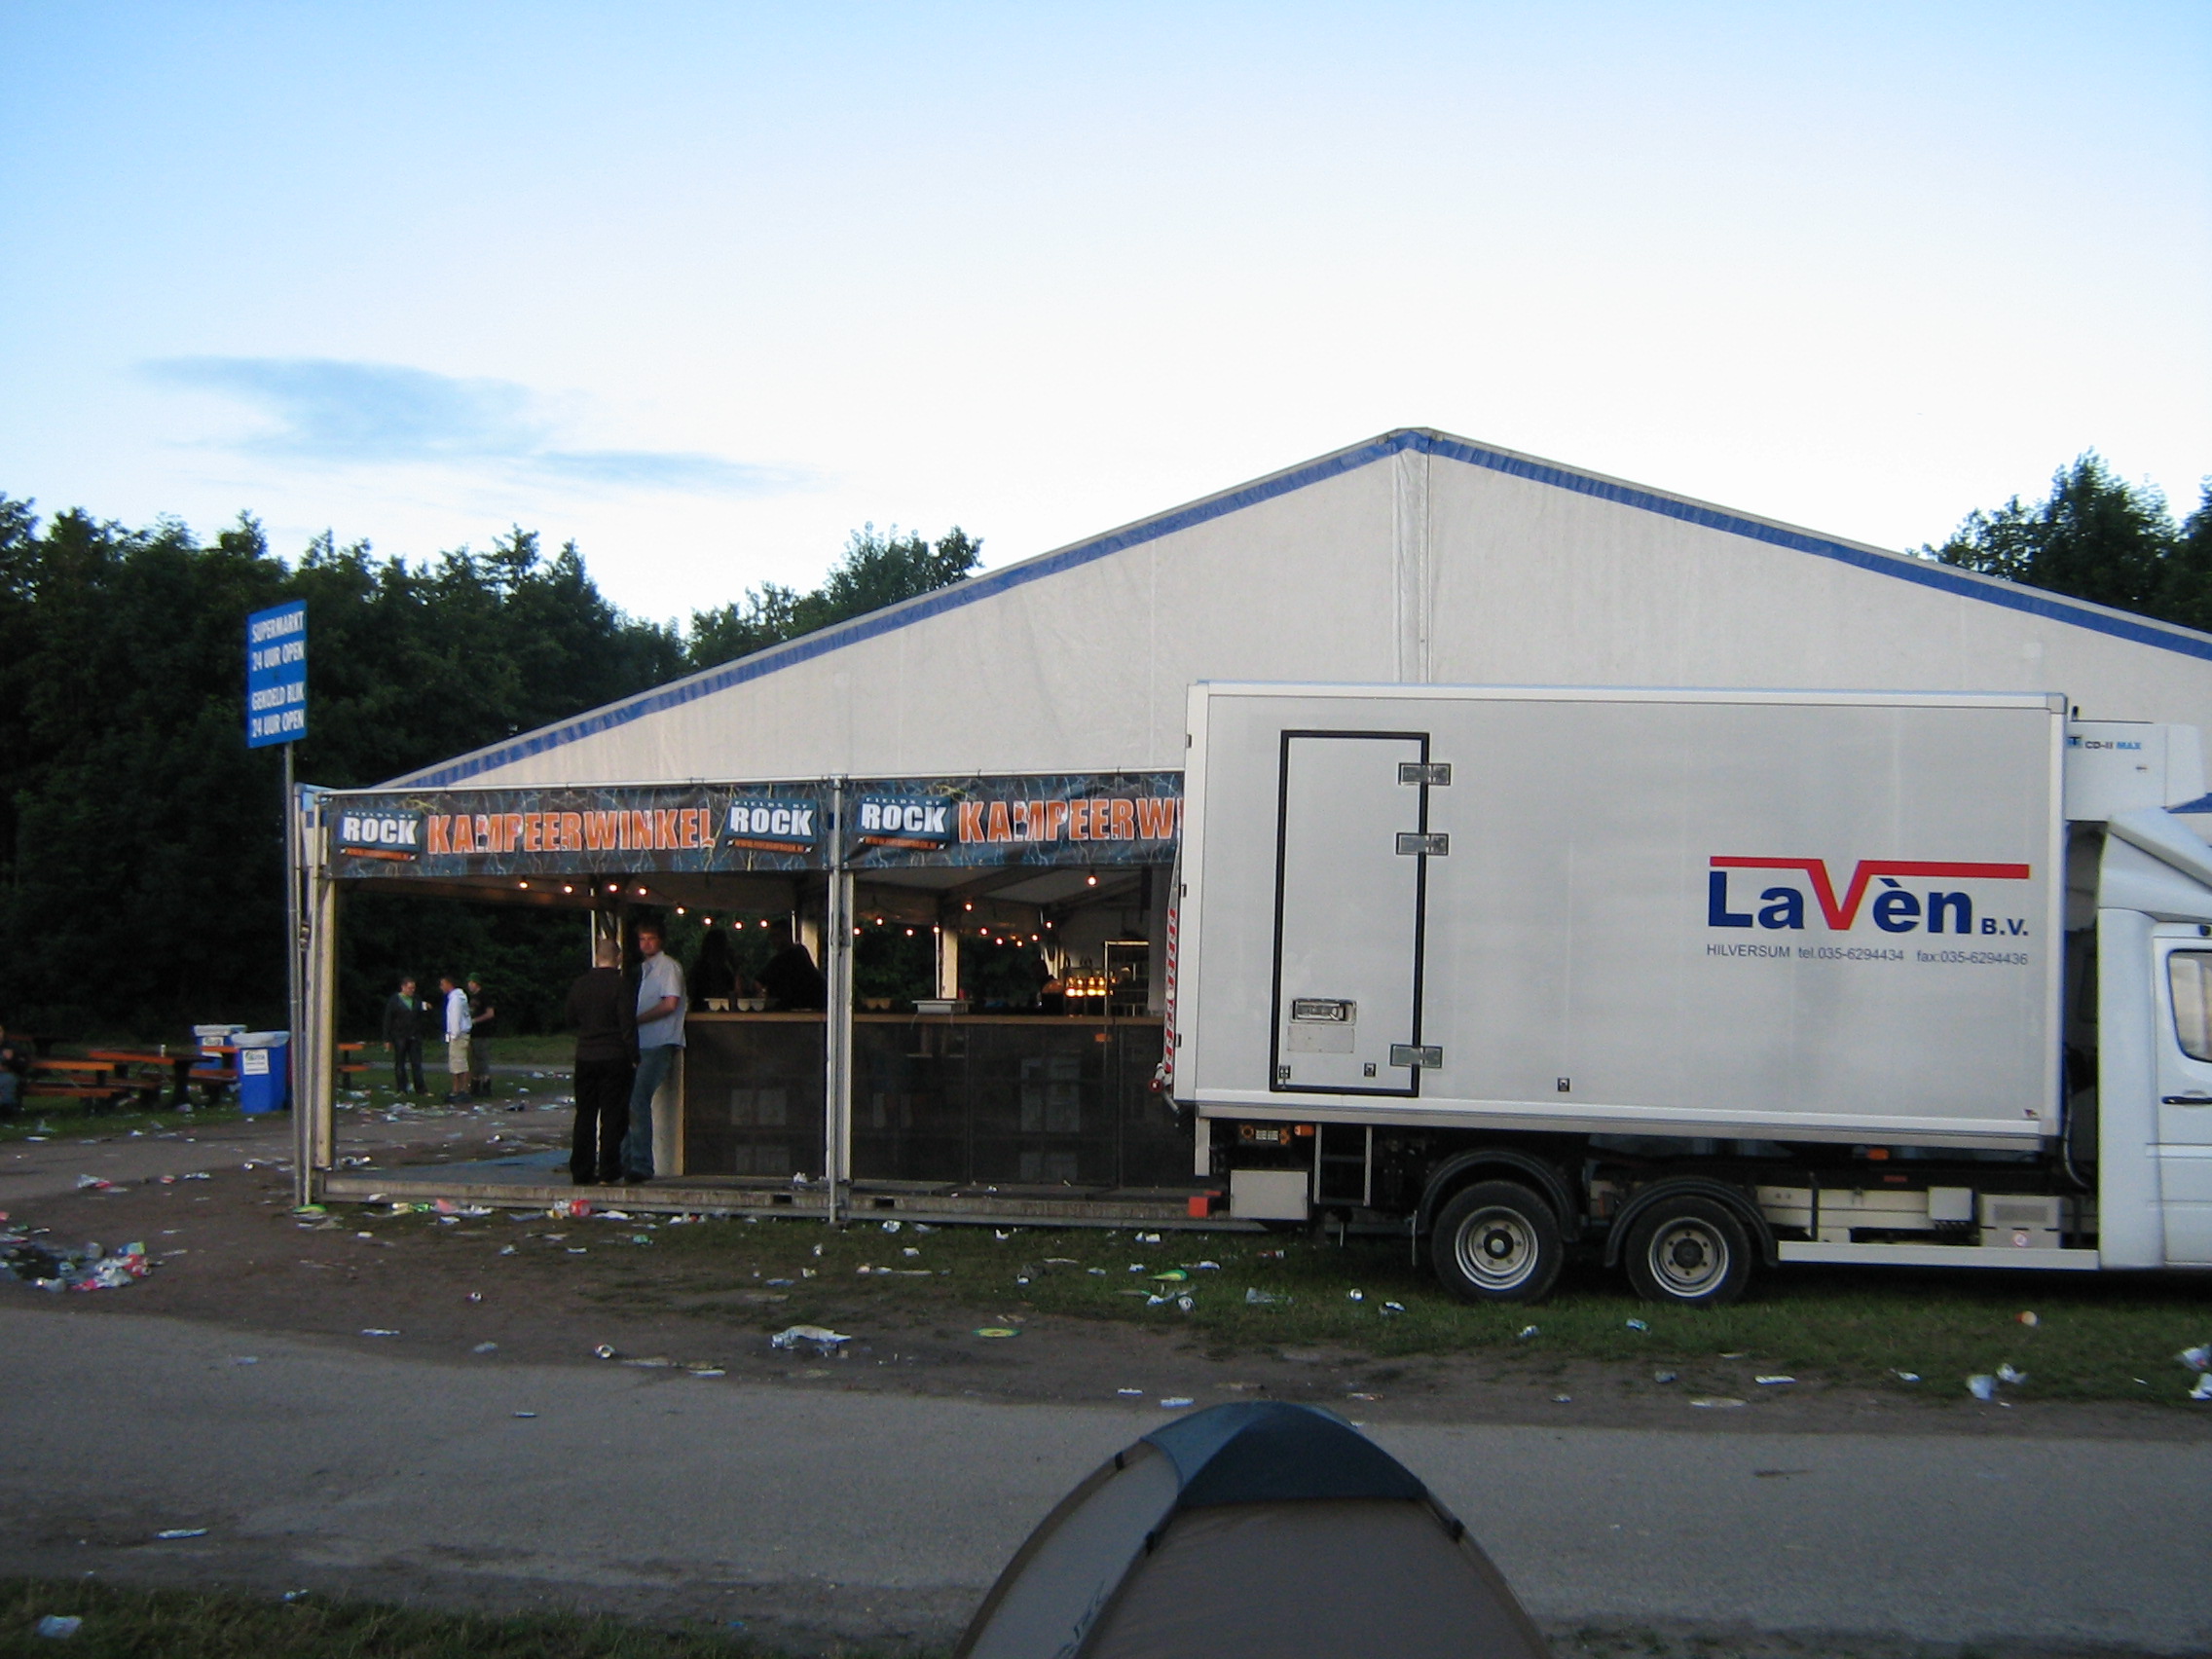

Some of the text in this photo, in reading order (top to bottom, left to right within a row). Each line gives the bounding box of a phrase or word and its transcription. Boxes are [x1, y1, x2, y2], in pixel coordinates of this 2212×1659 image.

[282, 641, 304, 663] OPEN
[282, 709, 304, 731] OPEN
[342, 816, 419, 845] ROCK
[427, 808, 716, 855] KAMPEERWINKEL
[729, 806, 814, 837] ROCK
[861, 803, 948, 833] ROCK
[1708, 857, 2030, 937] LaVèn B.V.
[1706, 943, 1791, 958] HILVERSUM
